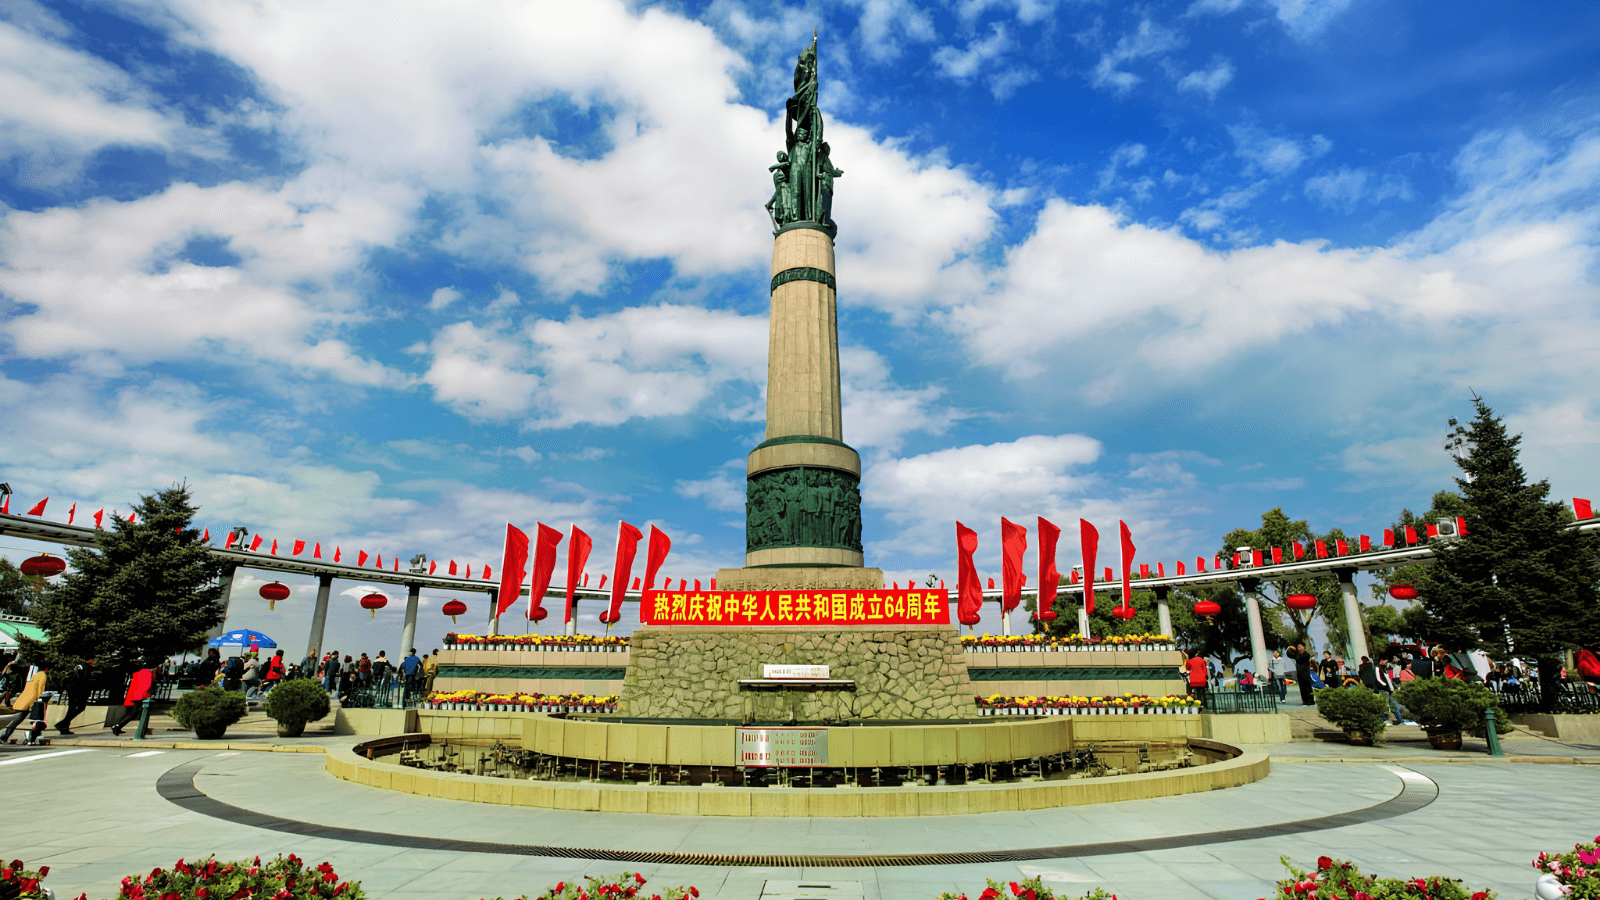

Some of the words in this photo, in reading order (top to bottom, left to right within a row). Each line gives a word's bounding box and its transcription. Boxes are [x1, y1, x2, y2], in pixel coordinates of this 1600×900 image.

[653, 592, 941, 622] 热烈庆祝中华人民共和国成立64周年
